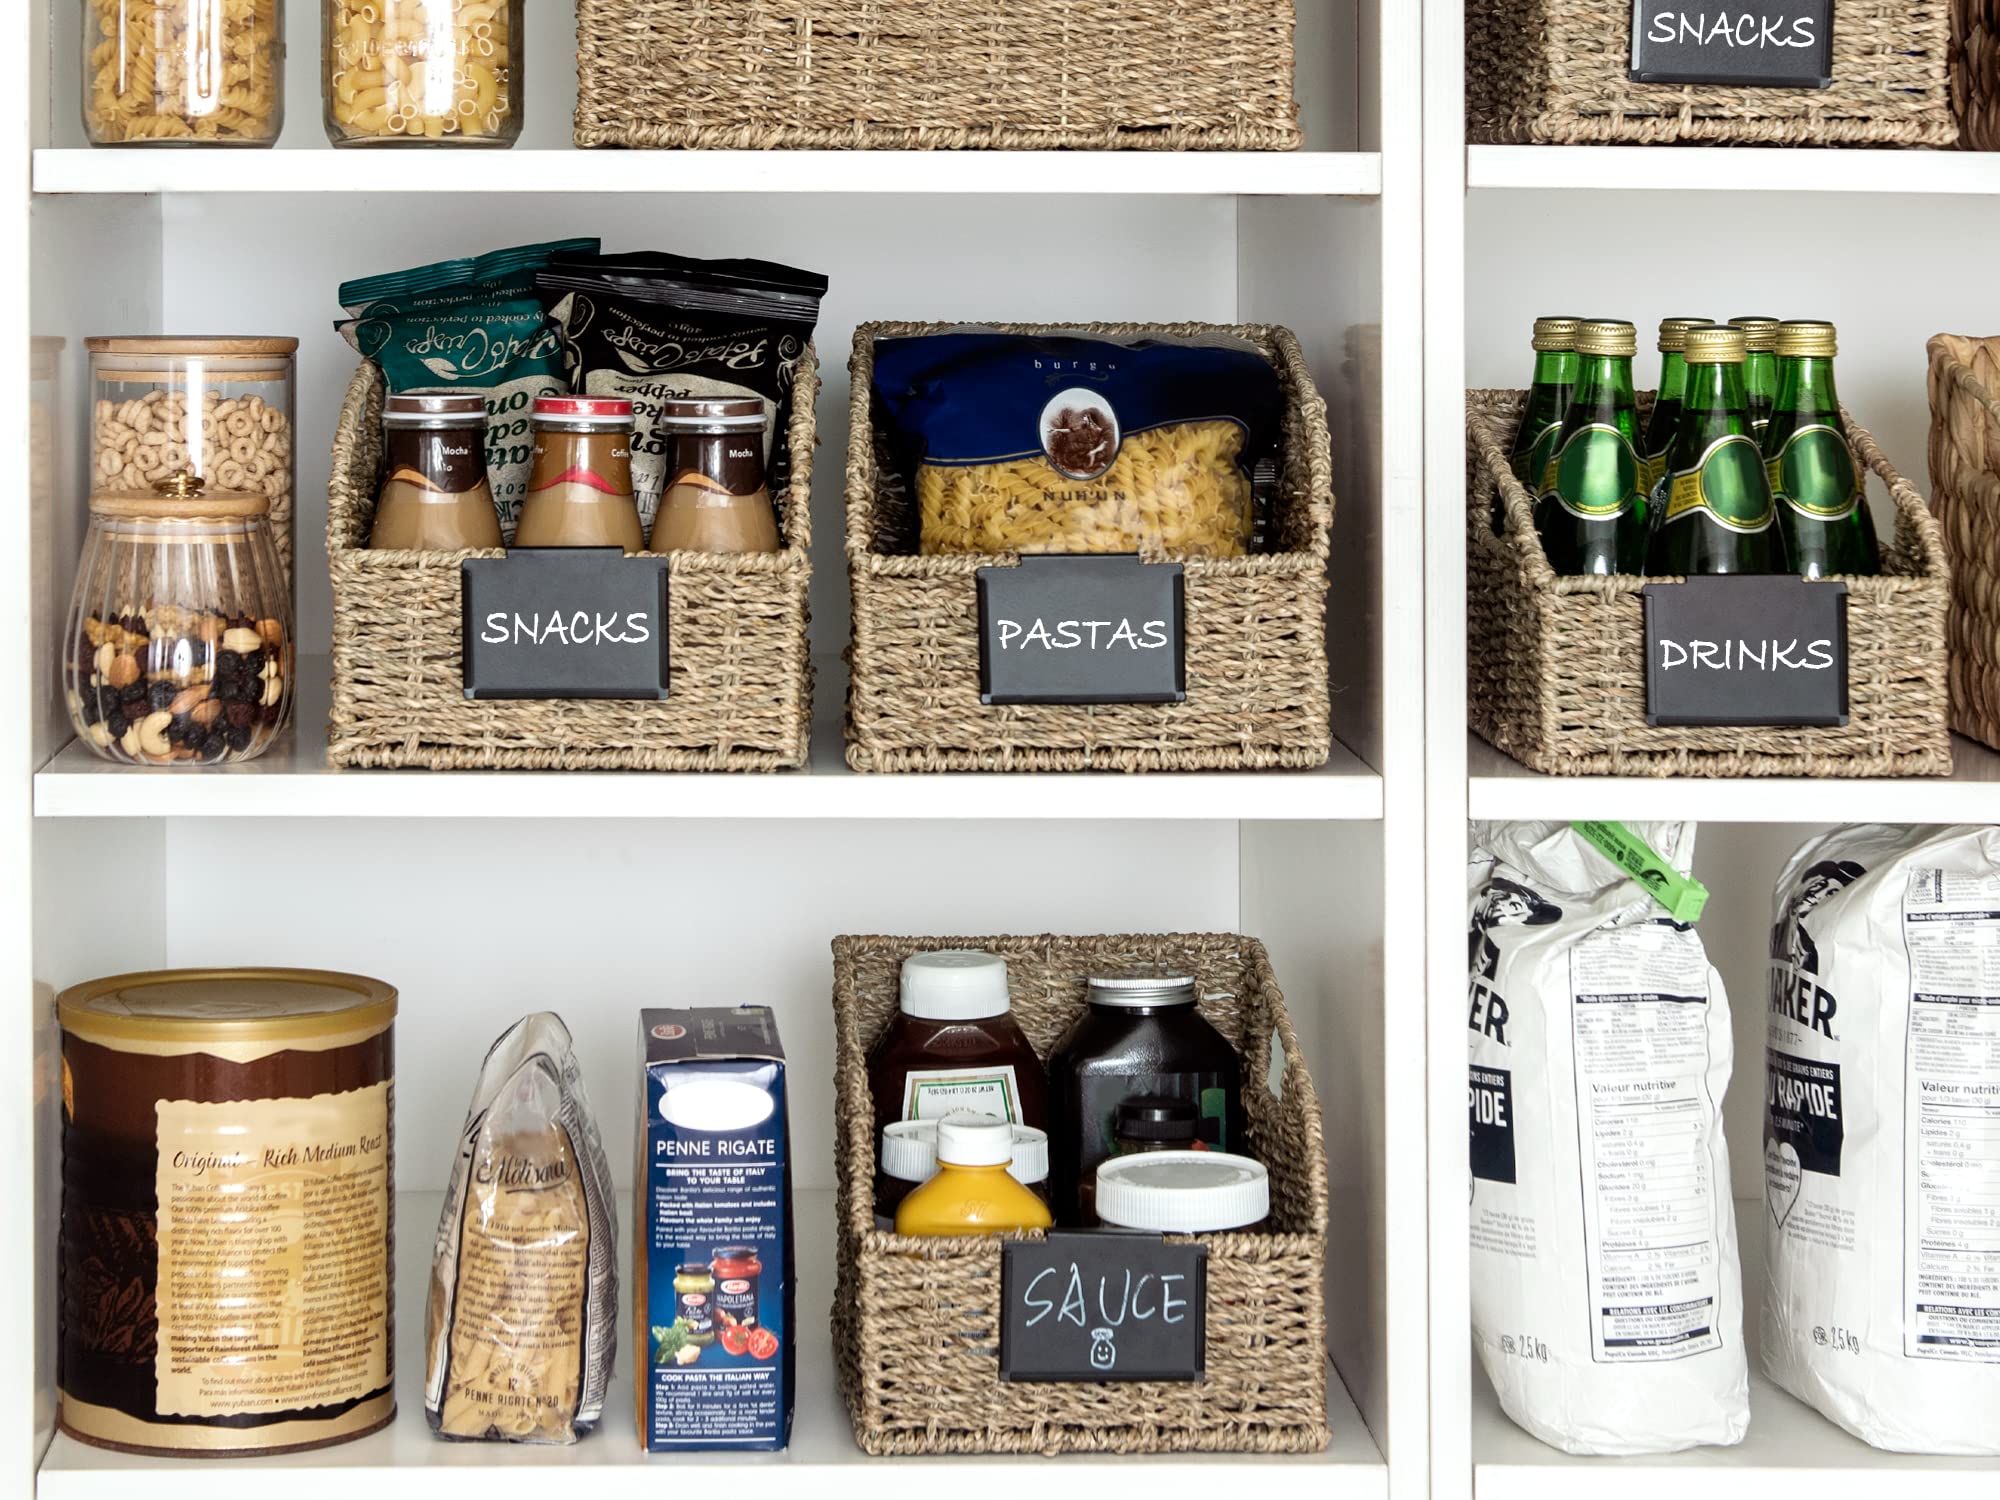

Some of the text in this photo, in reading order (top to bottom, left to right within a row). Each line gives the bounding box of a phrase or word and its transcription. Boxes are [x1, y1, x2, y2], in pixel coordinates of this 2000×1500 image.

[1647, 11, 1815, 49] SNACKS
[487, 312, 531, 324] cooked
[608, 306, 665, 339] perfection
[404, 326, 488, 370] Crisps
[600, 326, 768, 370] Potato Crisps
[442, 446, 469, 456] Mocha
[729, 450, 753, 459] Mocha
[481, 610, 650, 645] SNACKS
[997, 617, 1168, 650] PASTAS
[1659, 638, 1834, 671] DRINKS
[1810, 1064, 1834, 1081] ENTIERS
[1481, 1072, 1505, 1087] ENTIERS
[1592, 1082, 1630, 1093] Valeur
[1921, 1080, 2000, 1096] Valeur nutriti
[1777, 1073, 1838, 1120] RAPIDE
[1921, 1116, 1952, 1126] Calories
[1920, 1128, 1948, 1138] Lipides
[656, 1139, 775, 1156] PENNE RIGATE
[263, 1147, 300, 1169] Rich
[302, 1142, 357, 1164] Medium
[666, 1169, 689, 1177] BRING
[709, 1168, 730, 1176] TASTE
[733, 1168, 743, 1176] OF
[723, 1176, 745, 1184] TABLE
[745, 1216, 761, 1224] enjoy
[1921, 1238, 1957, 1248] Protéines
[1920, 1262, 1950, 1271] Calcium
[1918, 1281, 1944, 1290] CONTIENT
[716, 1293, 755, 1304] NAPOLETANA
[1024, 1261, 1188, 1328] SAUCE
[171, 1335, 197, 1346] making
[198, 1335, 221, 1344] Yuban
[1846, 1329, 1860, 1356] kg
[252, 1343, 280, 1352] Alliance
[1535, 1337, 1548, 1364] kg
[171, 1366, 193, 1375] world.
[661, 1374, 683, 1382] COOK
[685, 1374, 707, 1382] PASTA
[725, 1373, 752, 1381] ITALIAN
[753, 1372, 770, 1380] WAY
[464, 1387, 494, 1404] PENNE
[498, 1393, 532, 1407] RIGATE
[211, 1398, 274, 1409] www.yuban.com
